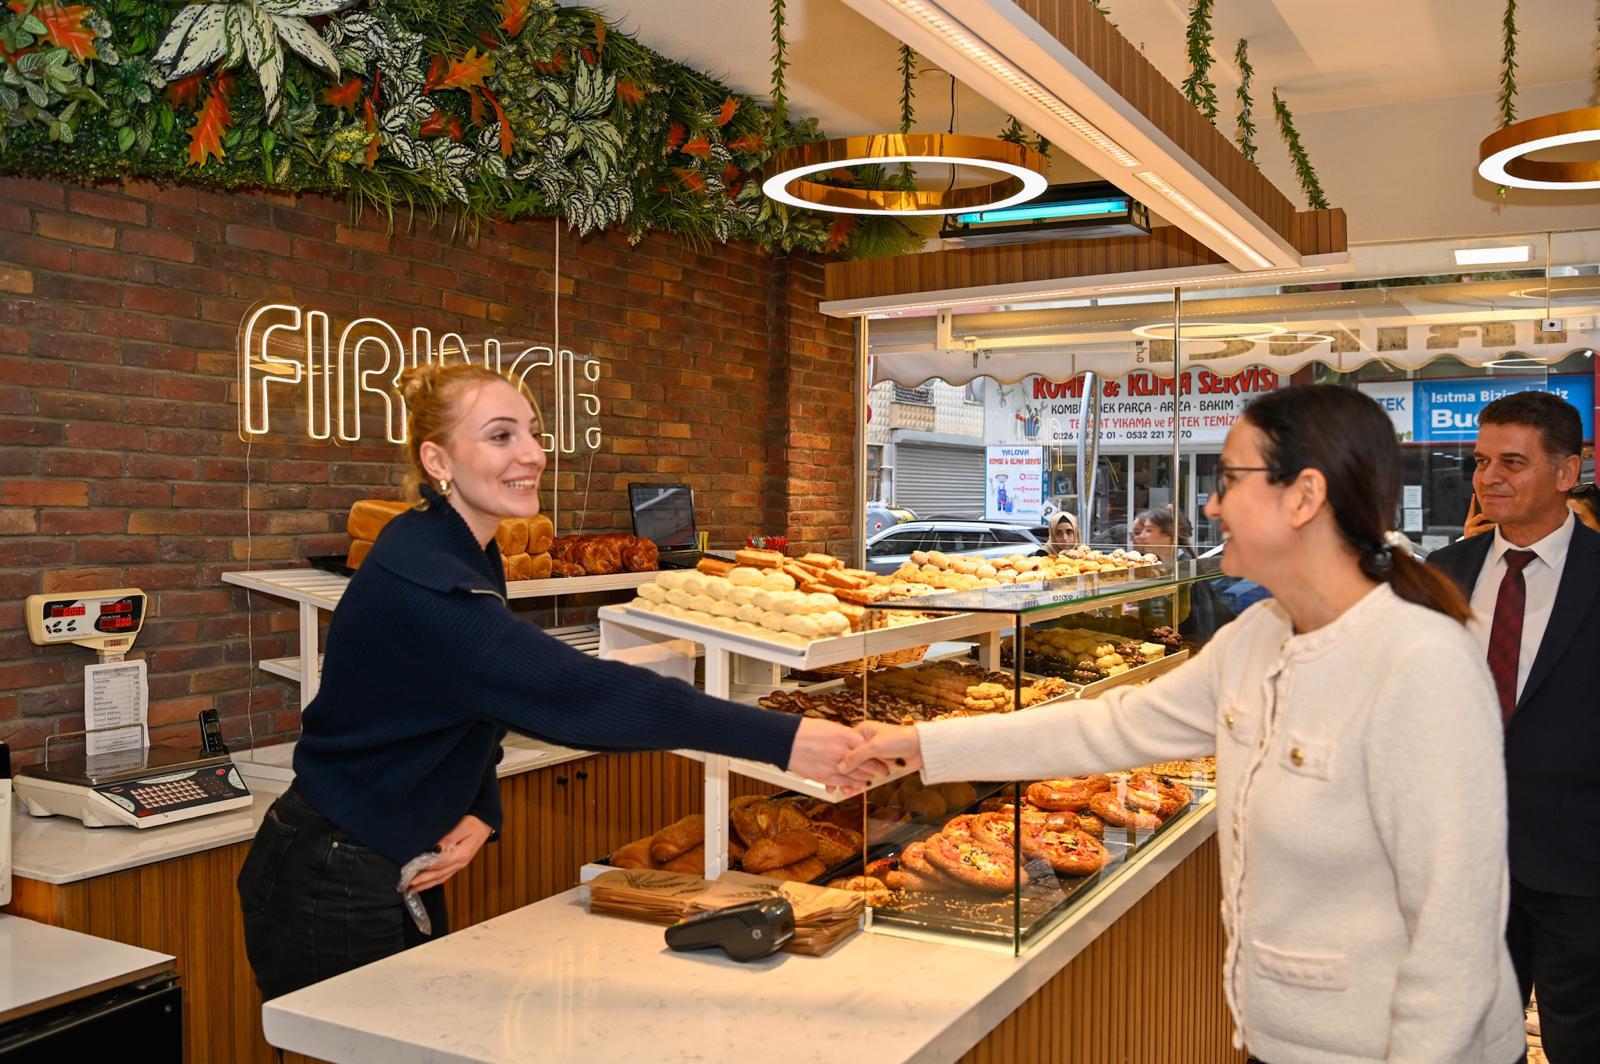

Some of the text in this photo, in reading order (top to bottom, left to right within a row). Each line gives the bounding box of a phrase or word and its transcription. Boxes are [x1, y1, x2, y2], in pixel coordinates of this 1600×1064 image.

[1118, 402, 1151, 415] PARÇA
[1160, 401, 1191, 413] ARZA
[1200, 400, 1234, 411] BAKIM
[1113, 417, 1152, 429] YIKAMA
[1154, 419, 1166, 428] ve
[1168, 415, 1200, 428] PTEK
[1126, 430, 1148, 439] 0532
[1150, 430, 1165, 439] 221
[1180, 429, 1192, 439] 70
